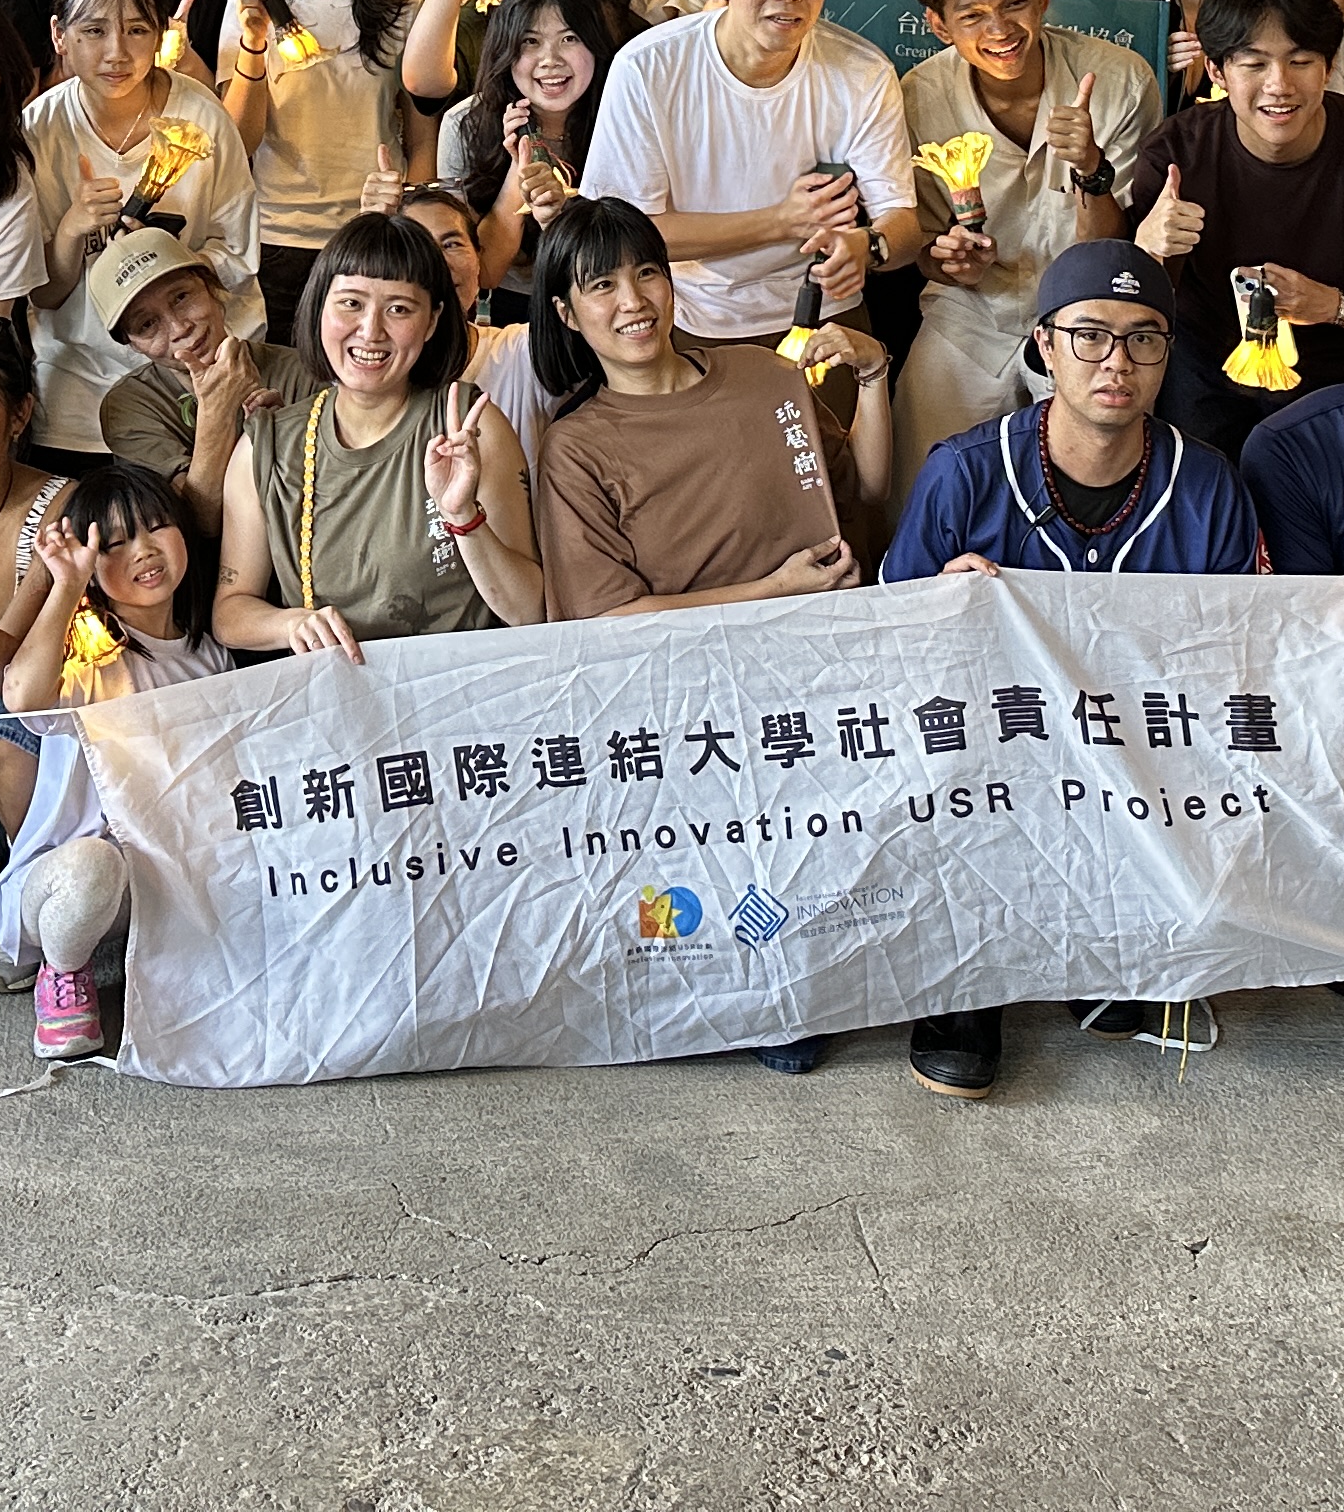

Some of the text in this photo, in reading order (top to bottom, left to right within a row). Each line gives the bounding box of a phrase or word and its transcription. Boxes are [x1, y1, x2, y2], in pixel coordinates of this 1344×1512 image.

[116, 251, 158, 286] BOSTON
[229, 684, 1283, 833] 創新國際連結大學社會責任計畫
[267, 779, 1272, 898] Inclusive Innovation USR Project
[796, 886, 904, 920] INNOVATION
